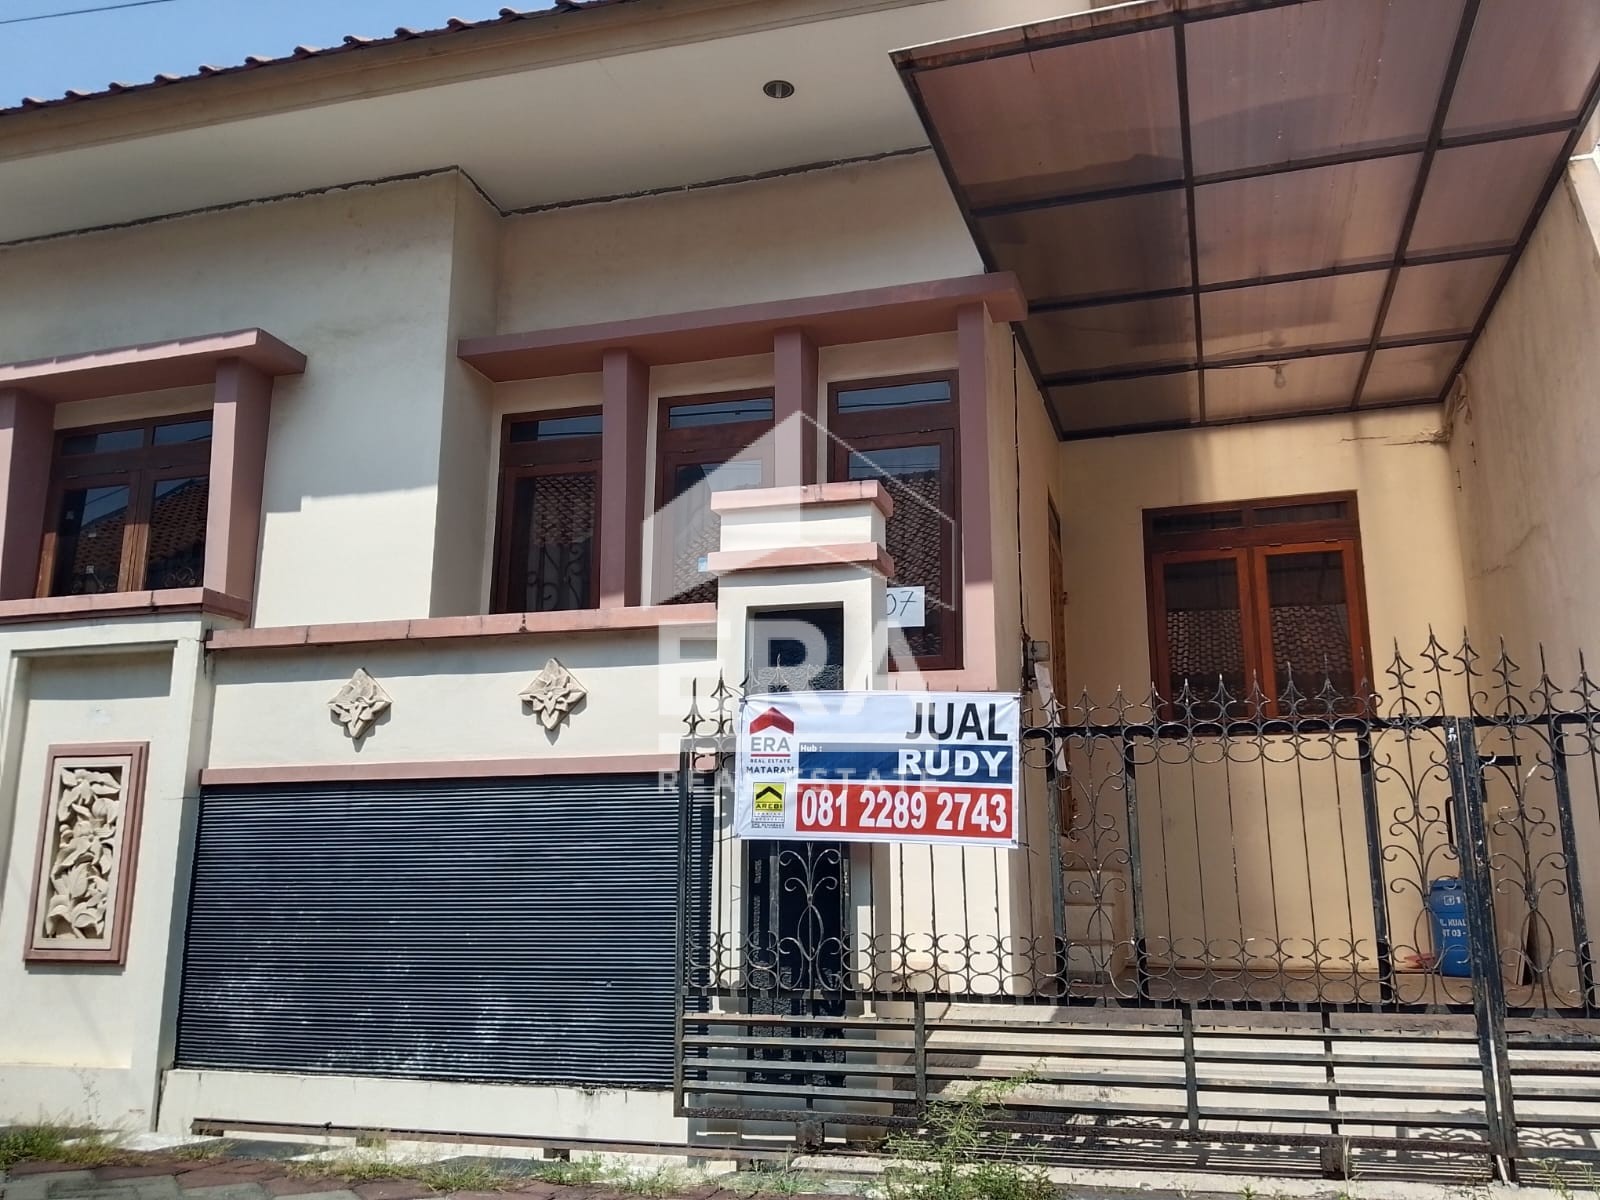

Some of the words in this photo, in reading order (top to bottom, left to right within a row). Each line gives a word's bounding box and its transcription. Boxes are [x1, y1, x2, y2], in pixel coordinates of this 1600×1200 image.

[905, 702, 1009, 741] JUAL
[750, 737, 791, 752] ERA
[800, 744, 818, 752] Hub
[746, 766, 794, 774] MATARAM
[899, 749, 1008, 777] RUDY
[801, 789, 849, 828] 081
[859, 790, 928, 829] 2289
[936, 793, 1007, 833] 2743
